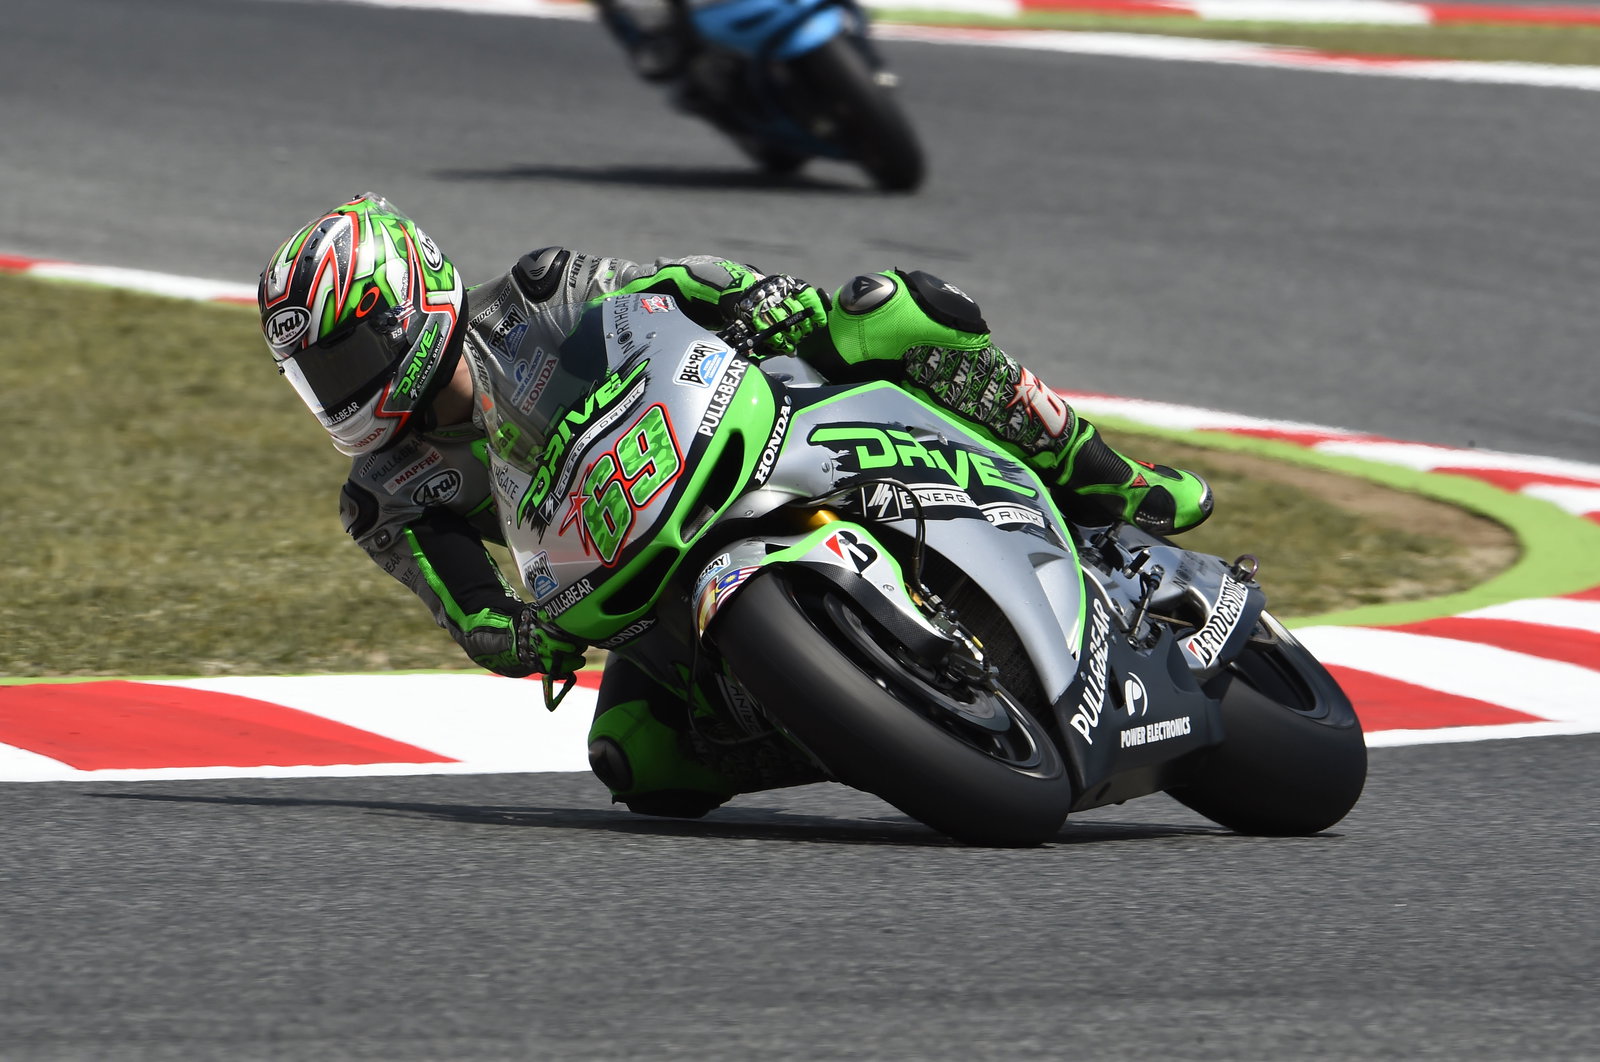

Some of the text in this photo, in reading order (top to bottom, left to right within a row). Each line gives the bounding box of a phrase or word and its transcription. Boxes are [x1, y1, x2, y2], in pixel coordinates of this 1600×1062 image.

[270, 310, 303, 344] Arai
[391, 327, 403, 339] 69
[614, 294, 636, 355] NORTHGATE
[392, 322, 438, 400] DRIVE
[521, 357, 559, 413] HONDA
[698, 359, 749, 437] PULL&BEAR
[394, 450, 440, 485] MAPFRE
[518, 358, 650, 528] DRIVE
[557, 388, 642, 497] ENERGY DRINK
[755, 405, 791, 485] HONDA
[422, 472, 456, 504] Arai
[584, 405, 681, 563] 69
[544, 578, 594, 620] PULL&BEAR
[602, 617, 656, 648] HONDA
[1069, 597, 1110, 745] PULL&BEAR
[1121, 716, 1192, 749] POWER ELECTRONICS
